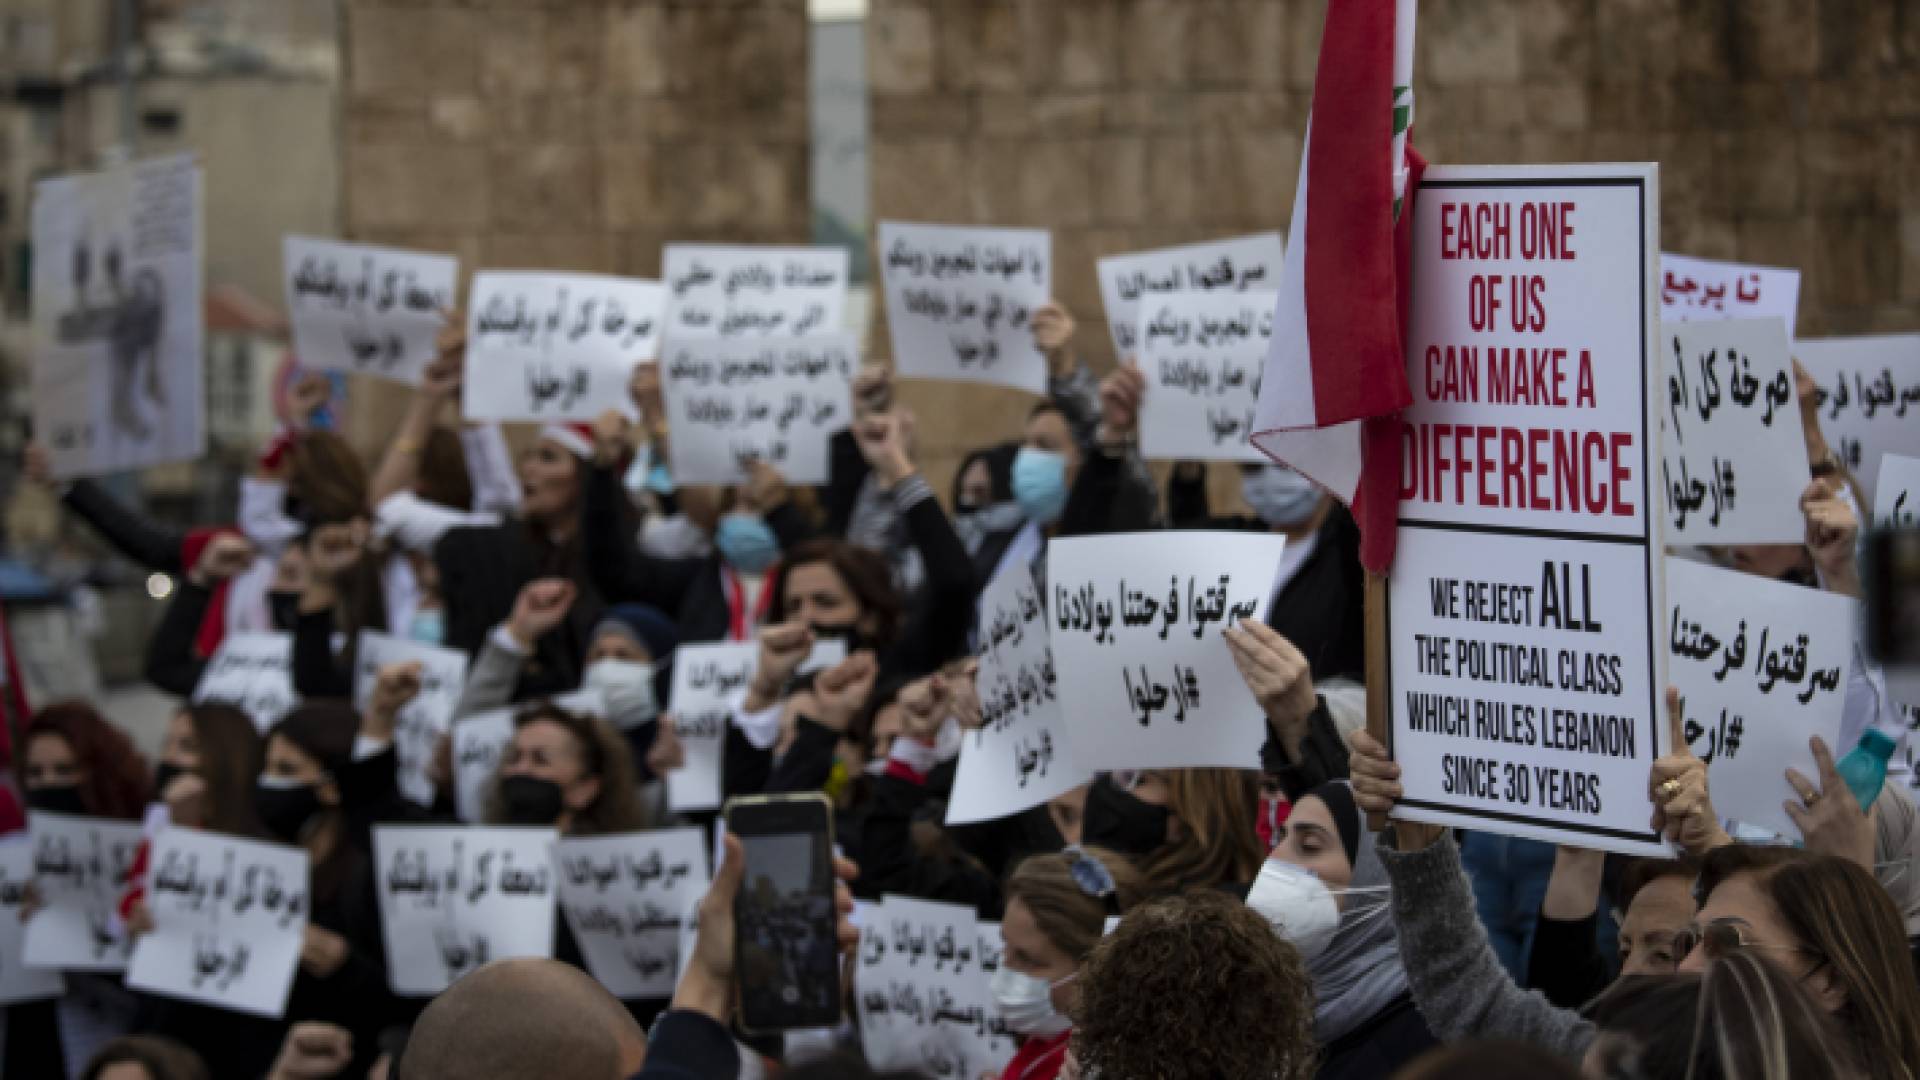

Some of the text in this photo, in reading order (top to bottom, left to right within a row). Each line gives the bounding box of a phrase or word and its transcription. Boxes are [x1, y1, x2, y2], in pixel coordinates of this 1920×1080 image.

[1441, 202, 1576, 260] EACH ONE
[1469, 274, 1546, 333] OF US
[1425, 345, 1597, 408] CAN MAKE A
[1668, 334, 1790, 445] صرخة كل أم
[1815, 368, 1848, 420] فرح
[1400, 423, 1635, 517] DIFFERENCE
[1663, 454, 1736, 531] #ارحلوا
[1056, 579, 1114, 644] بولادنا
[1119, 574, 1181, 640] فرحتنا
[1188, 574, 1258, 640] سرقتوا
[1430, 560, 1603, 633] WE REJECT ALL
[1414, 633, 1623, 697] THE POLITICAL CLASS
[1671, 604, 1841, 705] سرقتوا فرحتنا
[1122, 663, 1200, 727] #ارحلوا
[1406, 690, 1637, 759] WHICH RULES LEBANON
[1680, 696, 1744, 764] #ارح
[1441, 753, 1602, 815] SINCE 30 YEARS
